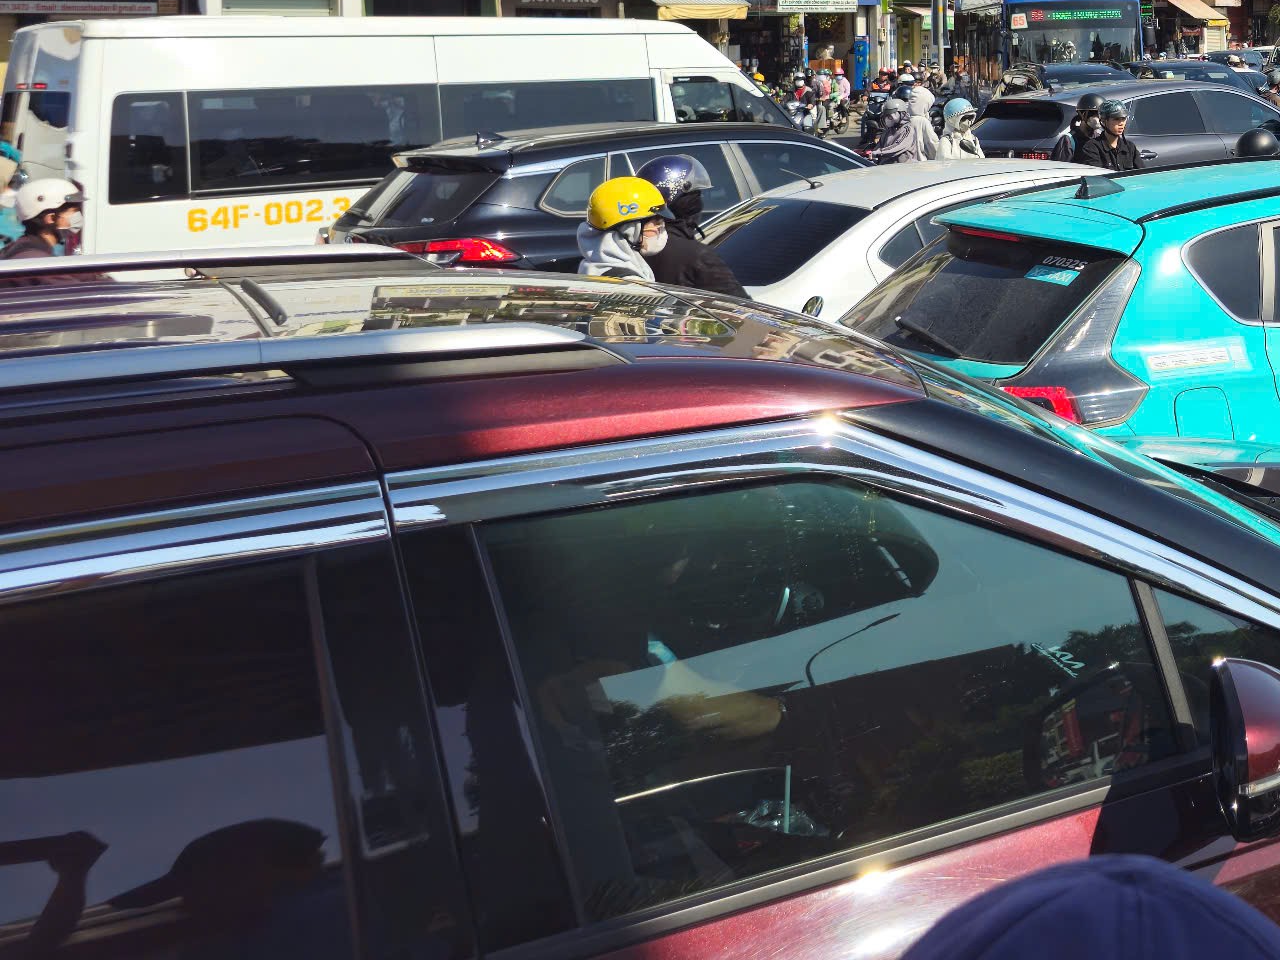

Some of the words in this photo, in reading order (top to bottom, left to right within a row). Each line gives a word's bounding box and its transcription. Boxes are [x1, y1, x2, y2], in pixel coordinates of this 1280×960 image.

[1012, 16, 1025, 26] 65
[187, 196, 350, 232] 64F-002.3
[617, 201, 639, 216] be
